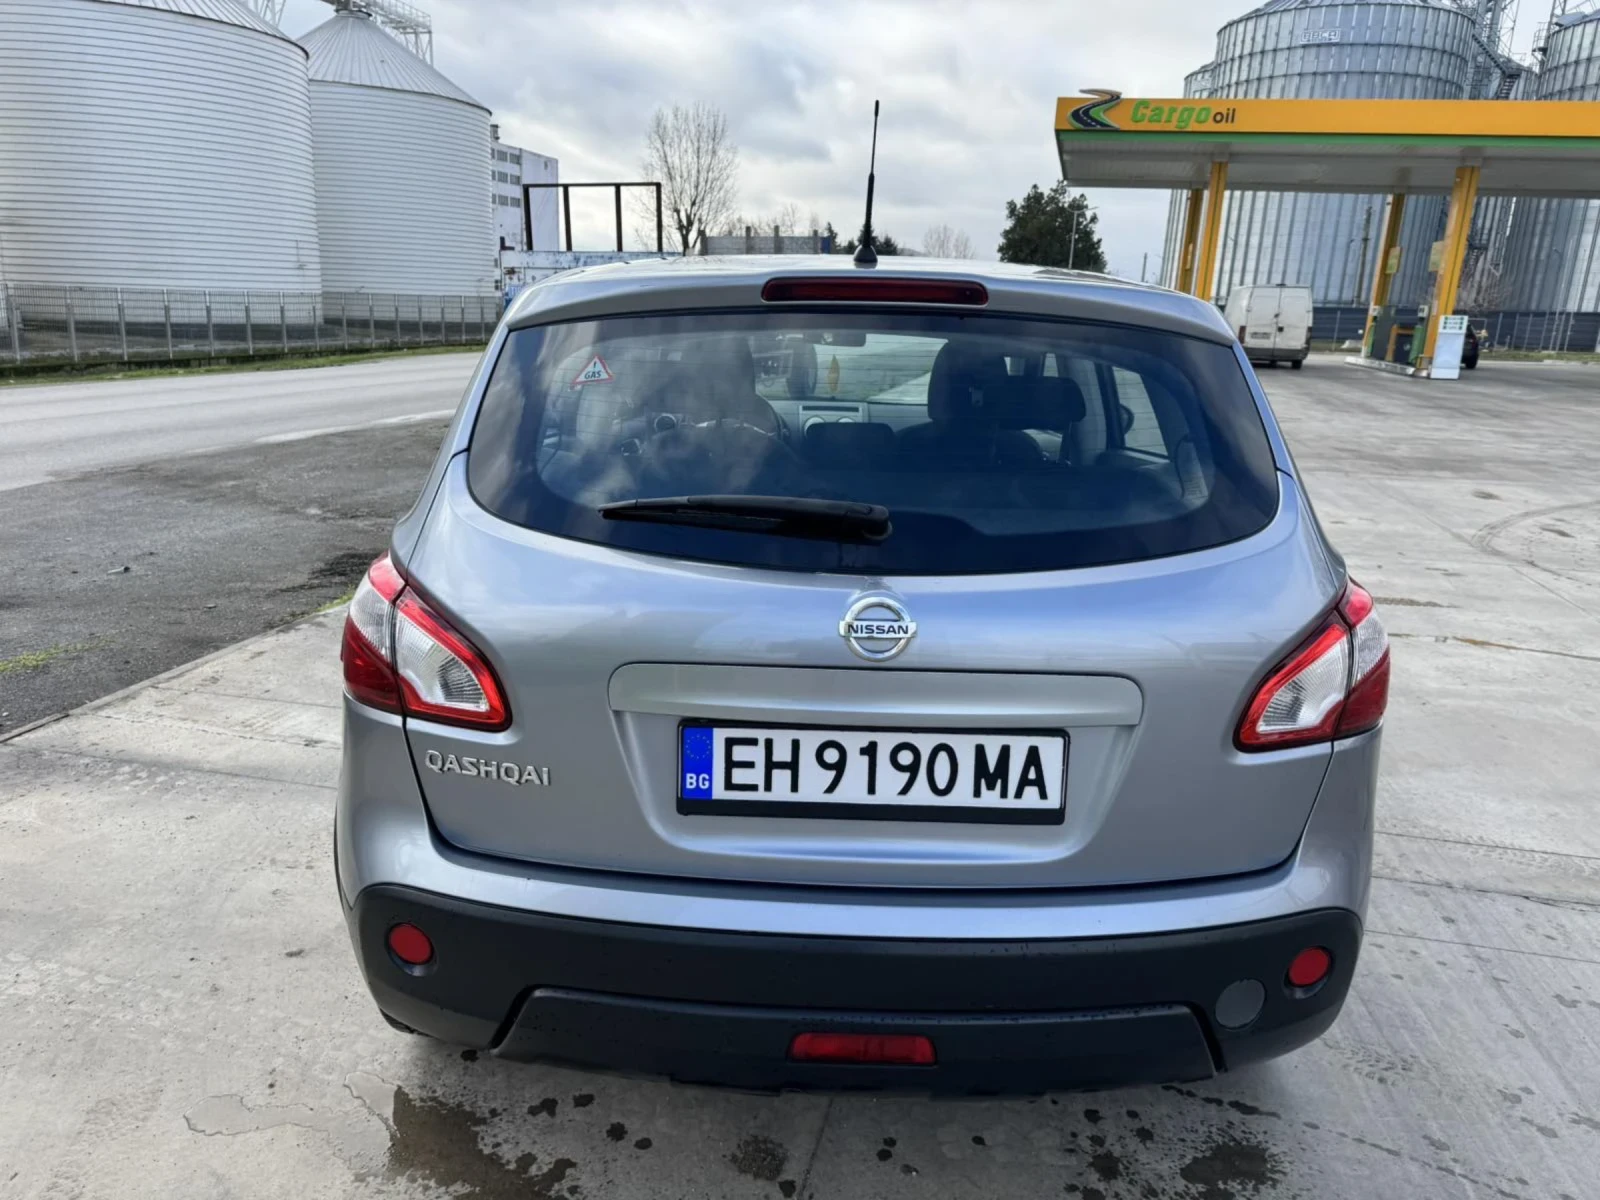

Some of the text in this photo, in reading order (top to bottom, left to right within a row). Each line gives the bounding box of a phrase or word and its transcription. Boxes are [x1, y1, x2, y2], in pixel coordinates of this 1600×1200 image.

[1131, 100, 1236, 129] Cargo oil
[584, 370, 602, 380] GAS
[847, 624, 909, 635] NISSAN
[425, 749, 550, 786] QASHQAI
[685, 736, 1048, 800] BG EH 9190 MA
